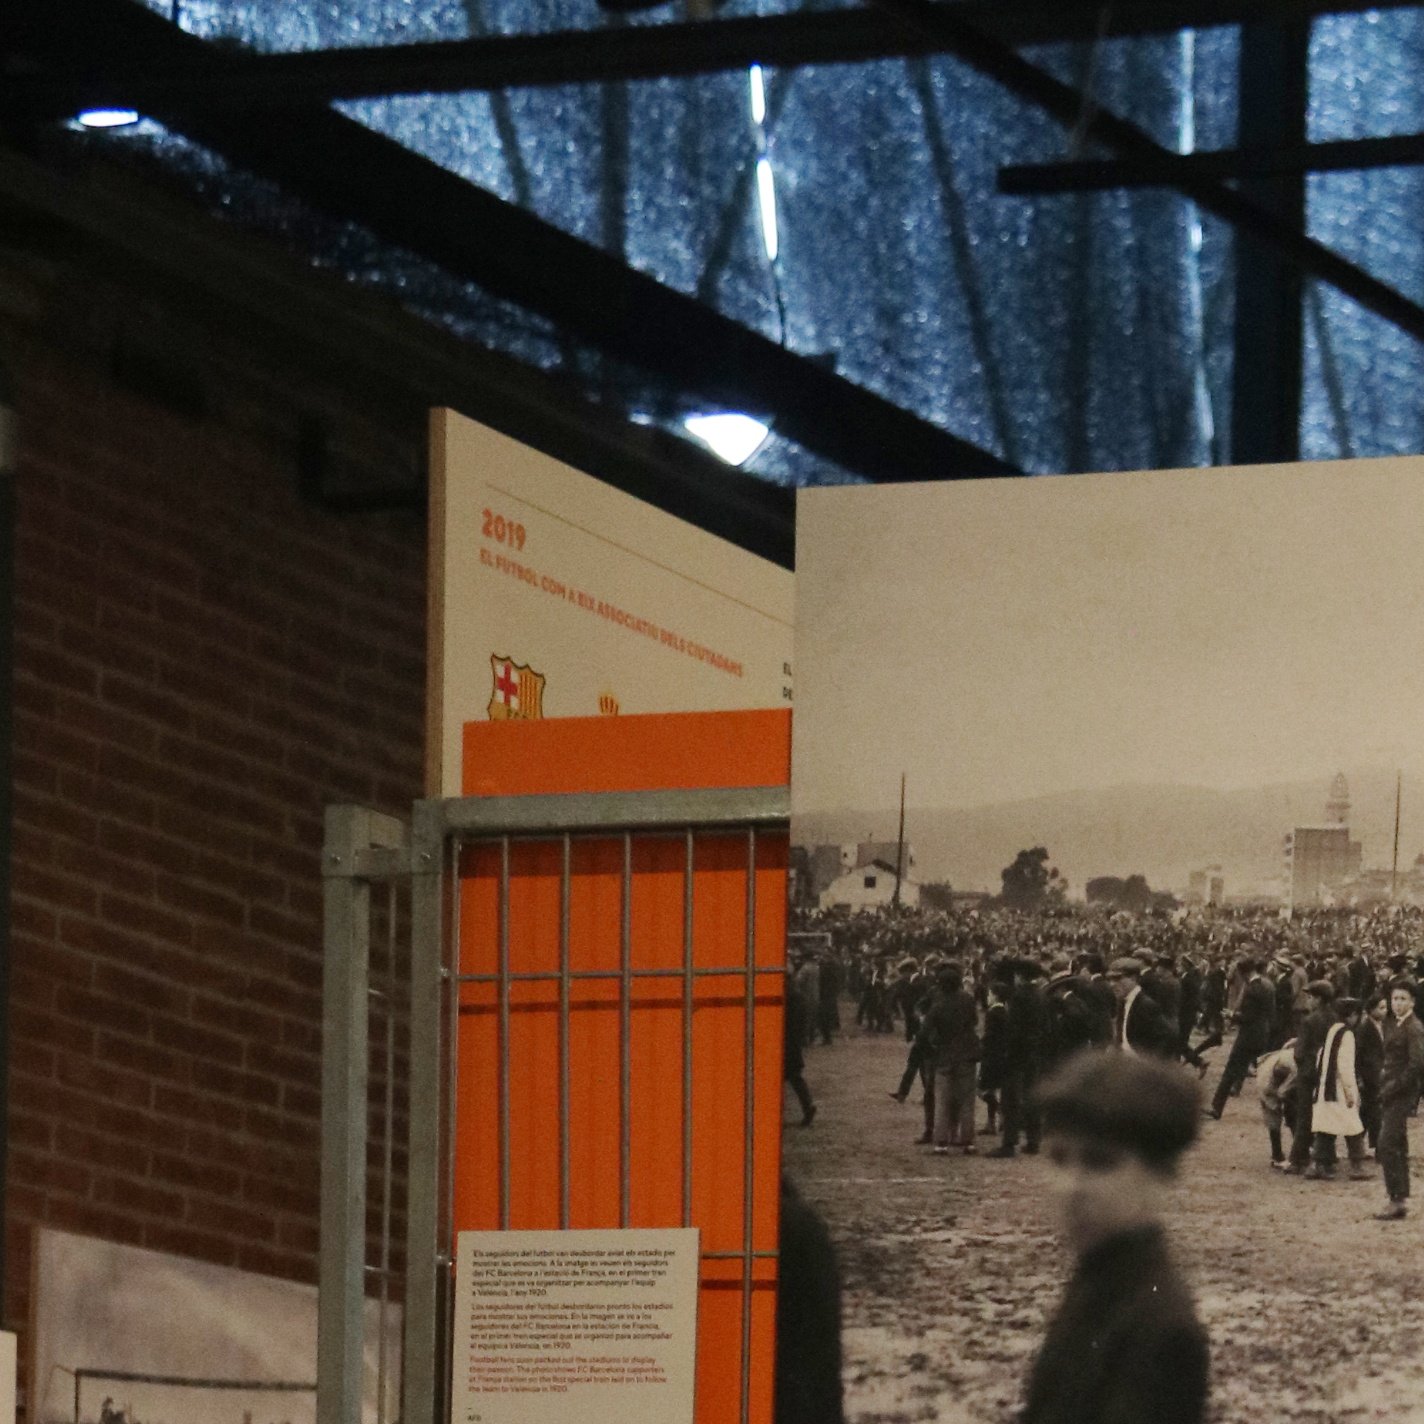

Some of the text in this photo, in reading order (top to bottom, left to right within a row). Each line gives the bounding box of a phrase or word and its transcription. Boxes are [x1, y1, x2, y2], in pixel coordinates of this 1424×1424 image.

[482, 508, 526, 552] 2019
[480, 548, 493, 567] EL
[496, 555, 538, 587] FUTBOL
[541, 576, 566, 599] COM
[569, 590, 576, 603] A
